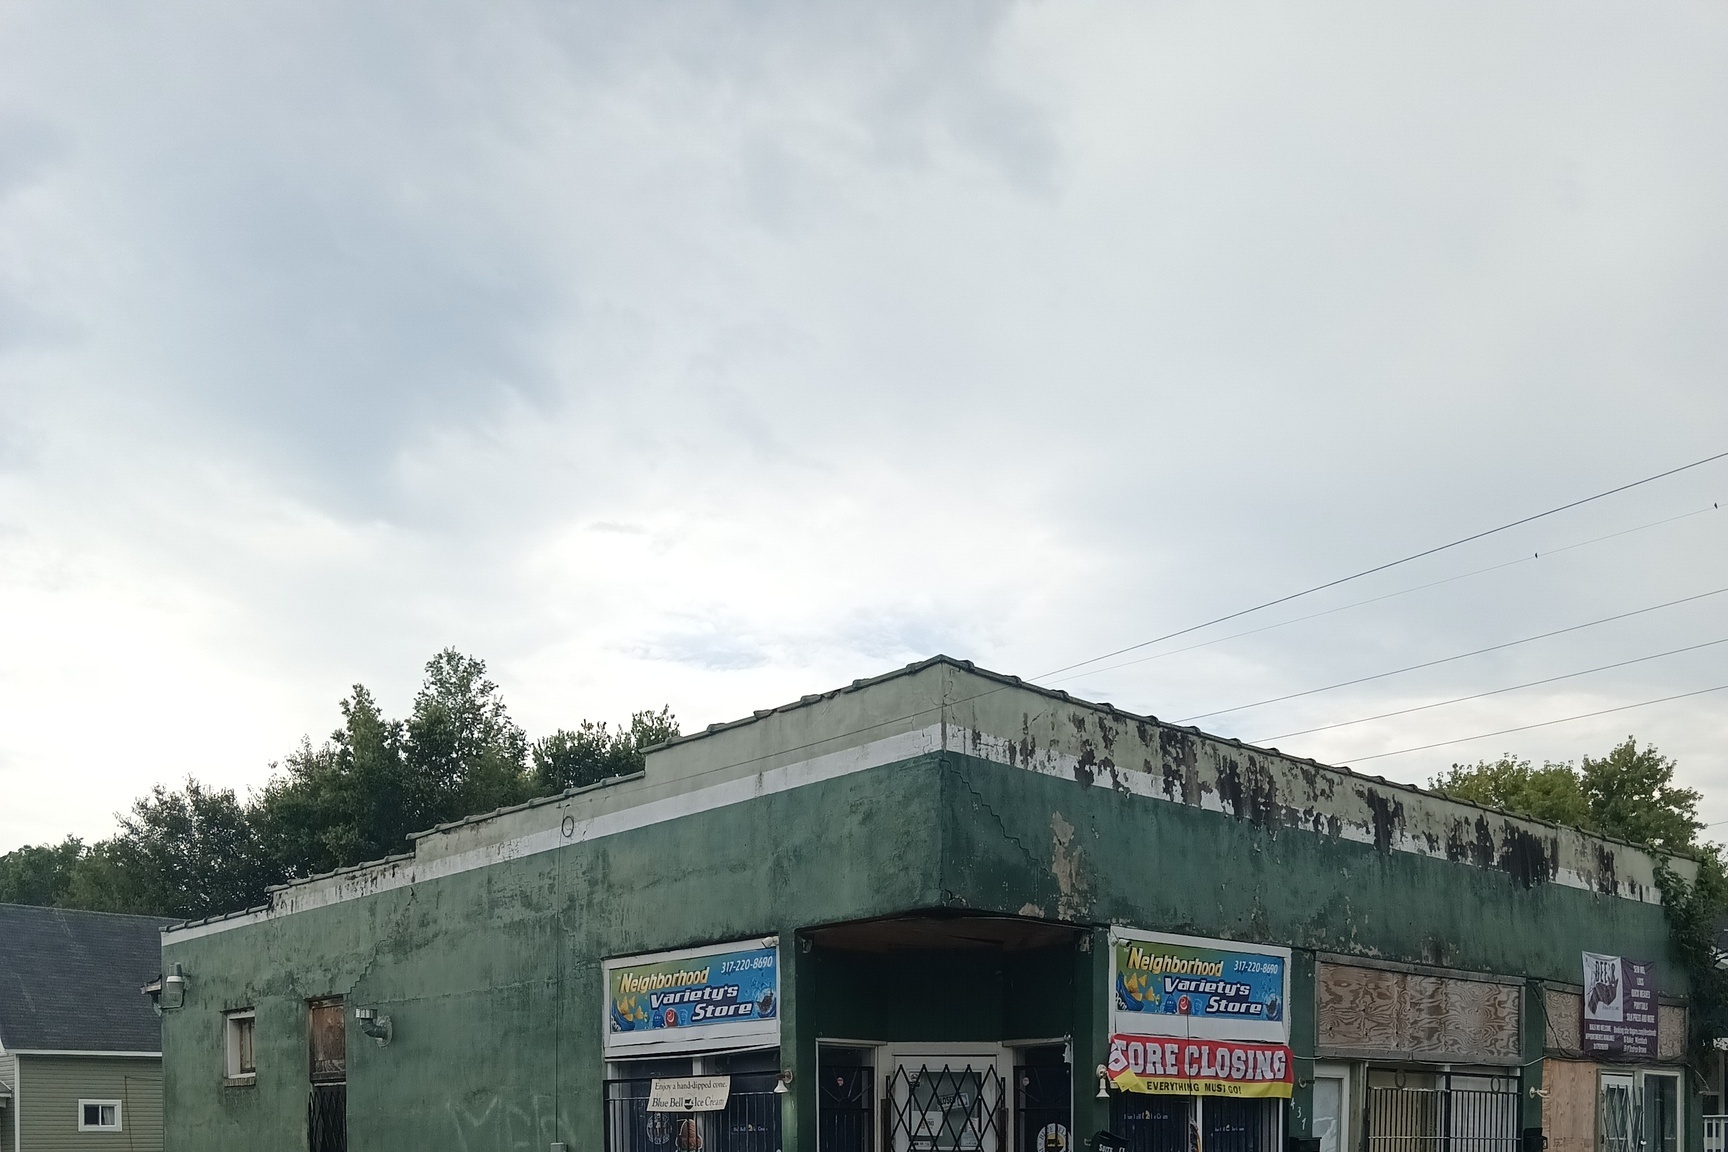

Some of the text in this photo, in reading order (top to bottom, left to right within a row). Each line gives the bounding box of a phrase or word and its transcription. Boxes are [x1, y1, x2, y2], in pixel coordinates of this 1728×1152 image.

[720, 956, 774, 974] 317-220-8690
[1127, 947, 1224, 977] Neighborhood
[1234, 960, 1279, 975] 317-220-8690
[619, 966, 711, 994] Neighborhood
[1164, 977, 1251, 996] Variety's
[650, 985, 739, 1009] Variety's
[1206, 997, 1262, 1014] Store
[692, 1003, 753, 1021] Store
[1184, 1045, 1287, 1080] CLOSING
[654, 1082, 671, 1091] Enjoy
[677, 1080, 712, 1090] hand-dipped
[1146, 1081, 1199, 1092] EVERYTHING
[1227, 1085, 1242, 1095] GO!
[652, 1096, 725, 1108] Blue Bell Ice Cream
